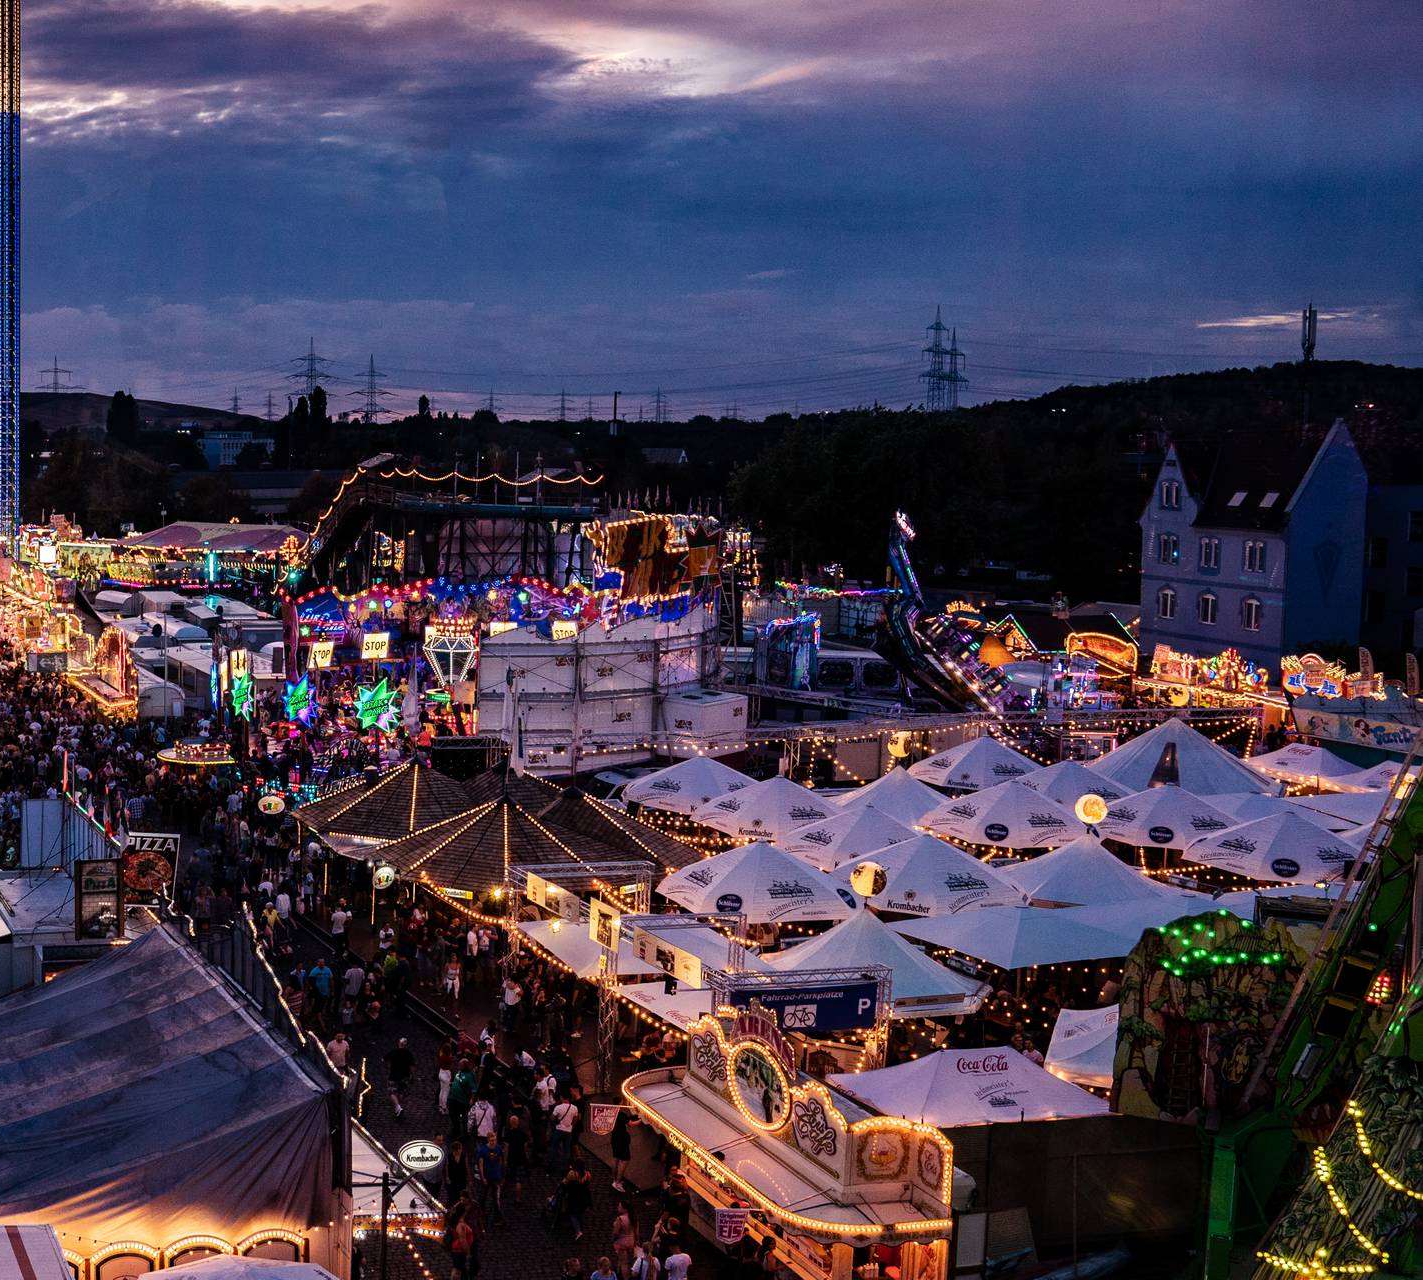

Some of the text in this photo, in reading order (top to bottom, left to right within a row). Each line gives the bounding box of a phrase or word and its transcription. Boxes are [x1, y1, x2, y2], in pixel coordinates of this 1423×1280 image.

[365, 641, 387, 652] STOP
[313, 649, 331, 660] STOP
[947, 779, 979, 789] Krombacher
[738, 827, 773, 838] Krombacher
[128, 837, 176, 851] PIZZA
[887, 900, 930, 914] Krombacher
[761, 991, 844, 1002] Fahrrad-Parkplätze
[858, 998, 871, 1015] P
[957, 1055, 1009, 1074] Coca-Cola
[407, 1153, 439, 1162] Krombacher
[719, 1225, 743, 1238] EIS
